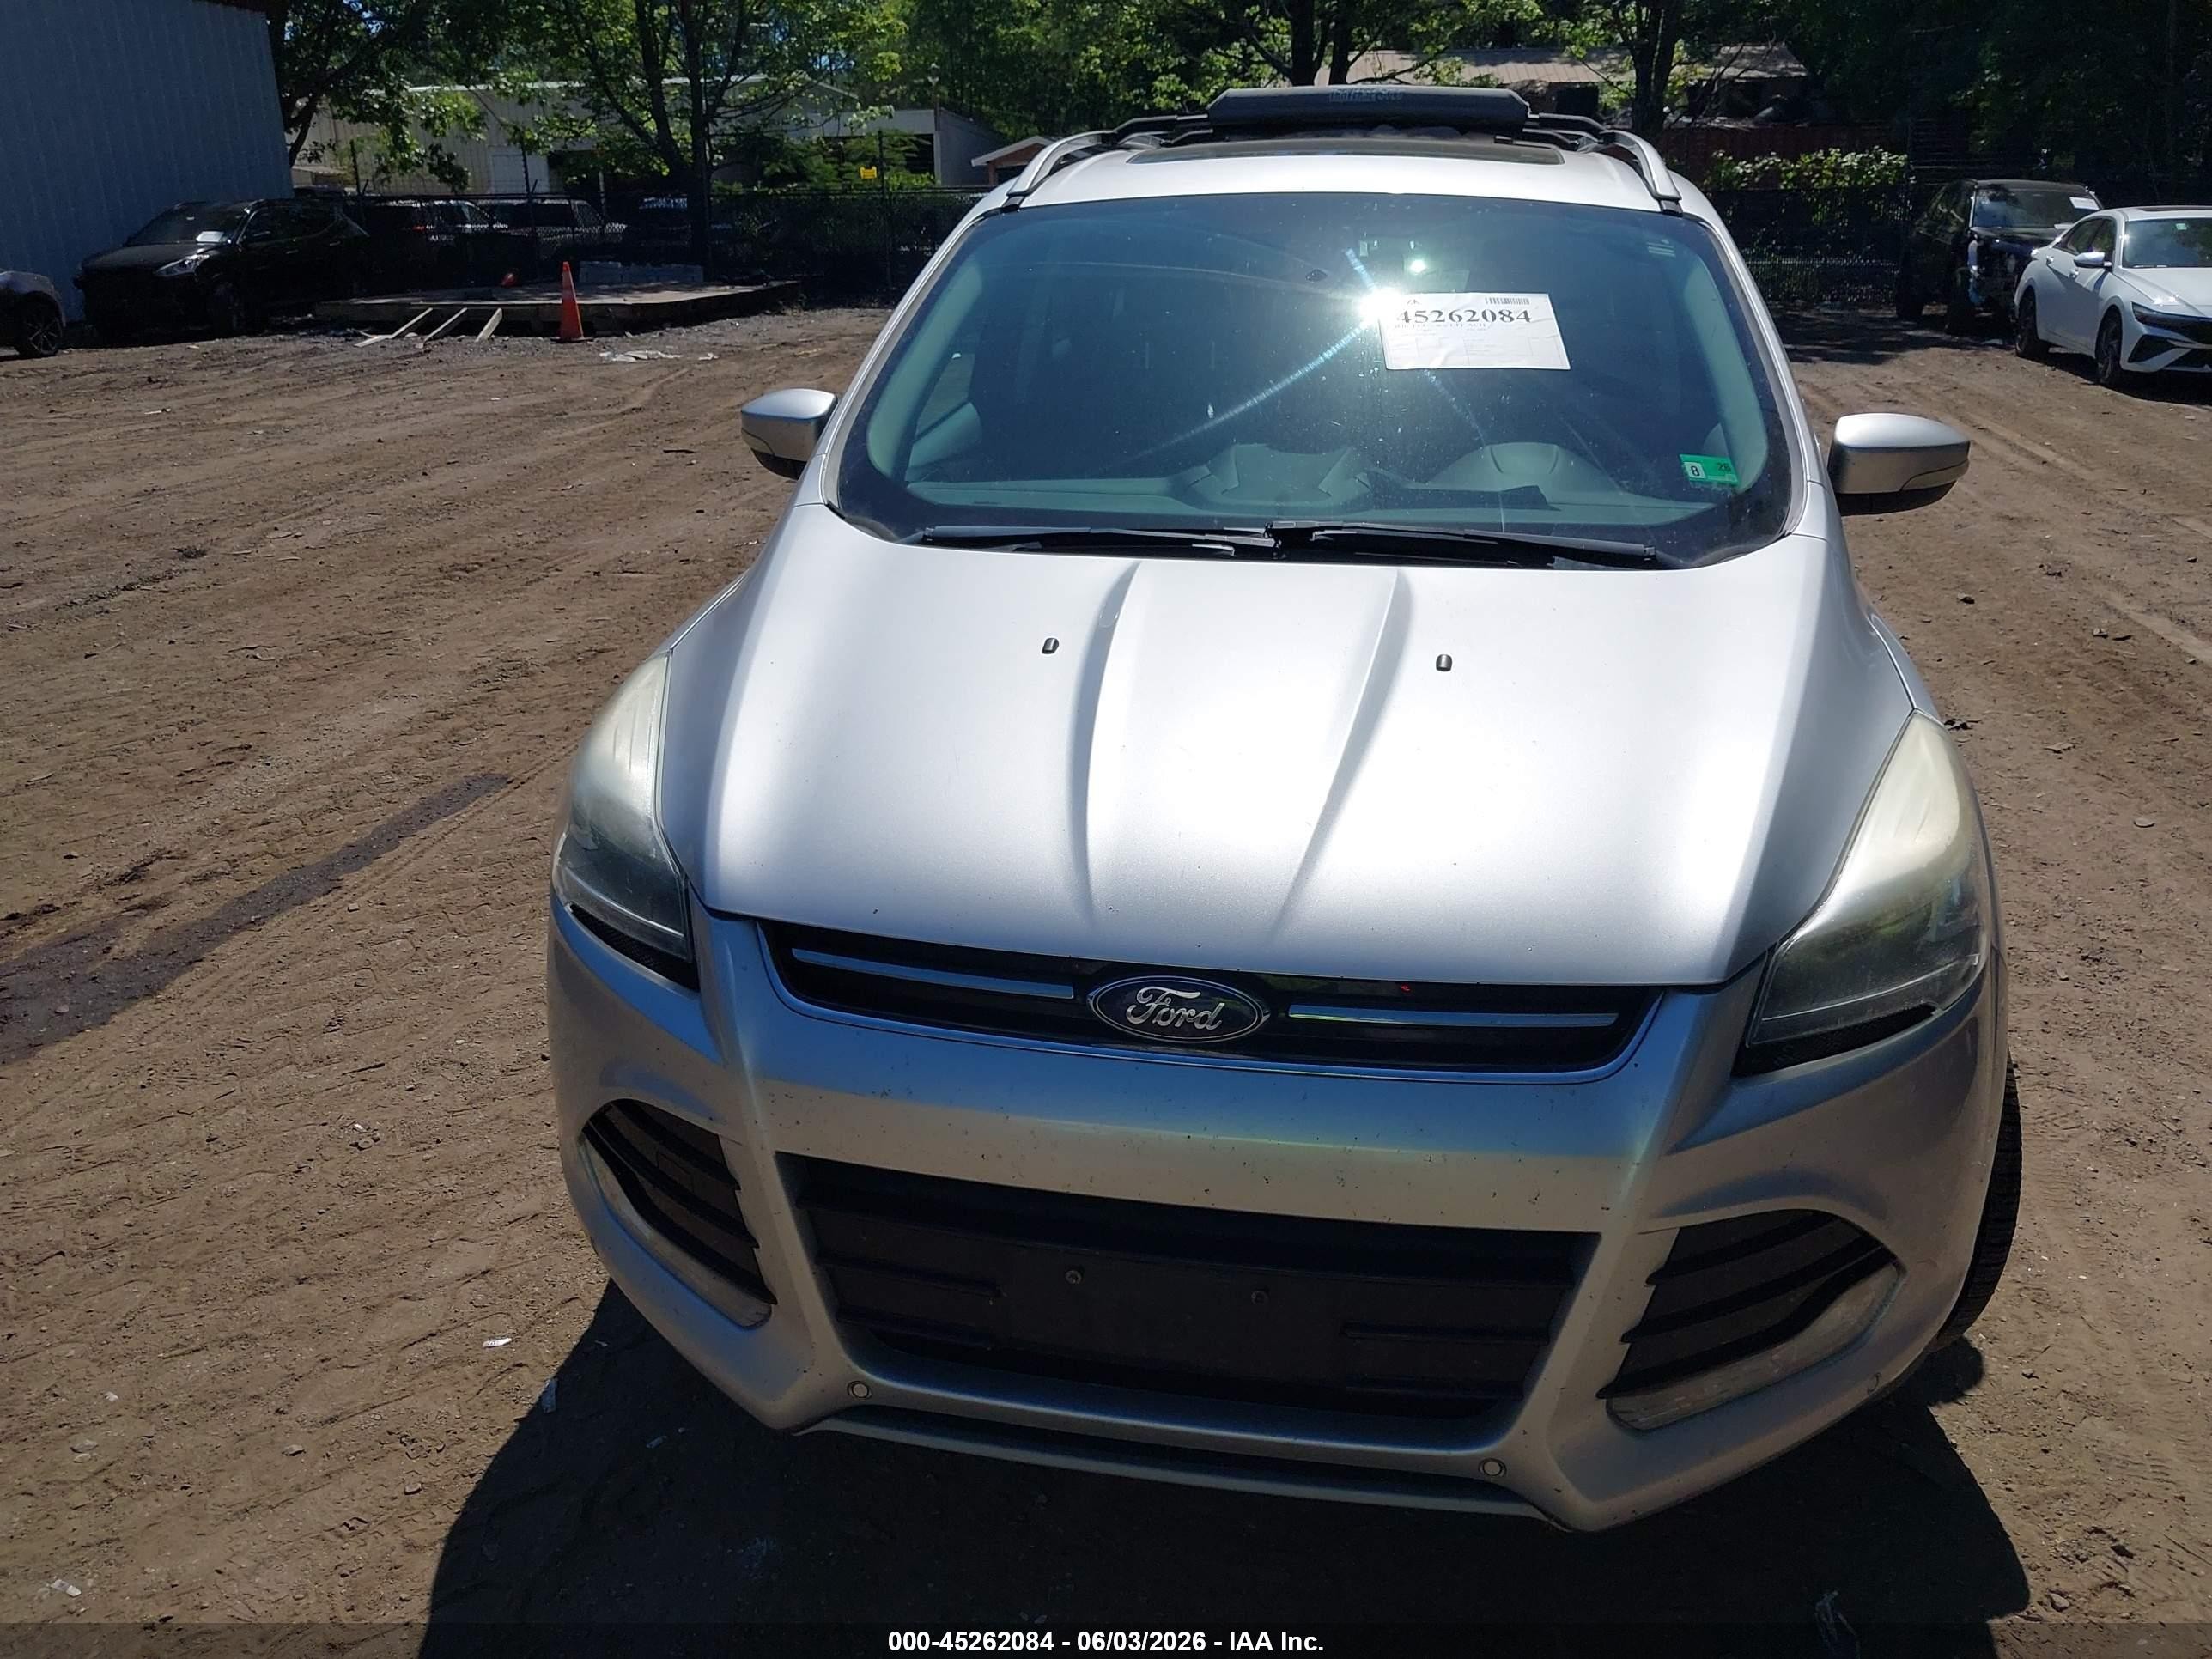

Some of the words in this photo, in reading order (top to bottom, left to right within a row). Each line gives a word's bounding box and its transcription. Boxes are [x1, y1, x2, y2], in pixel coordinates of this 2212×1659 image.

[1396, 309, 1532, 324] 45262084
[1690, 465, 1700, 477] 8
[1126, 986, 1225, 1030] Ford
